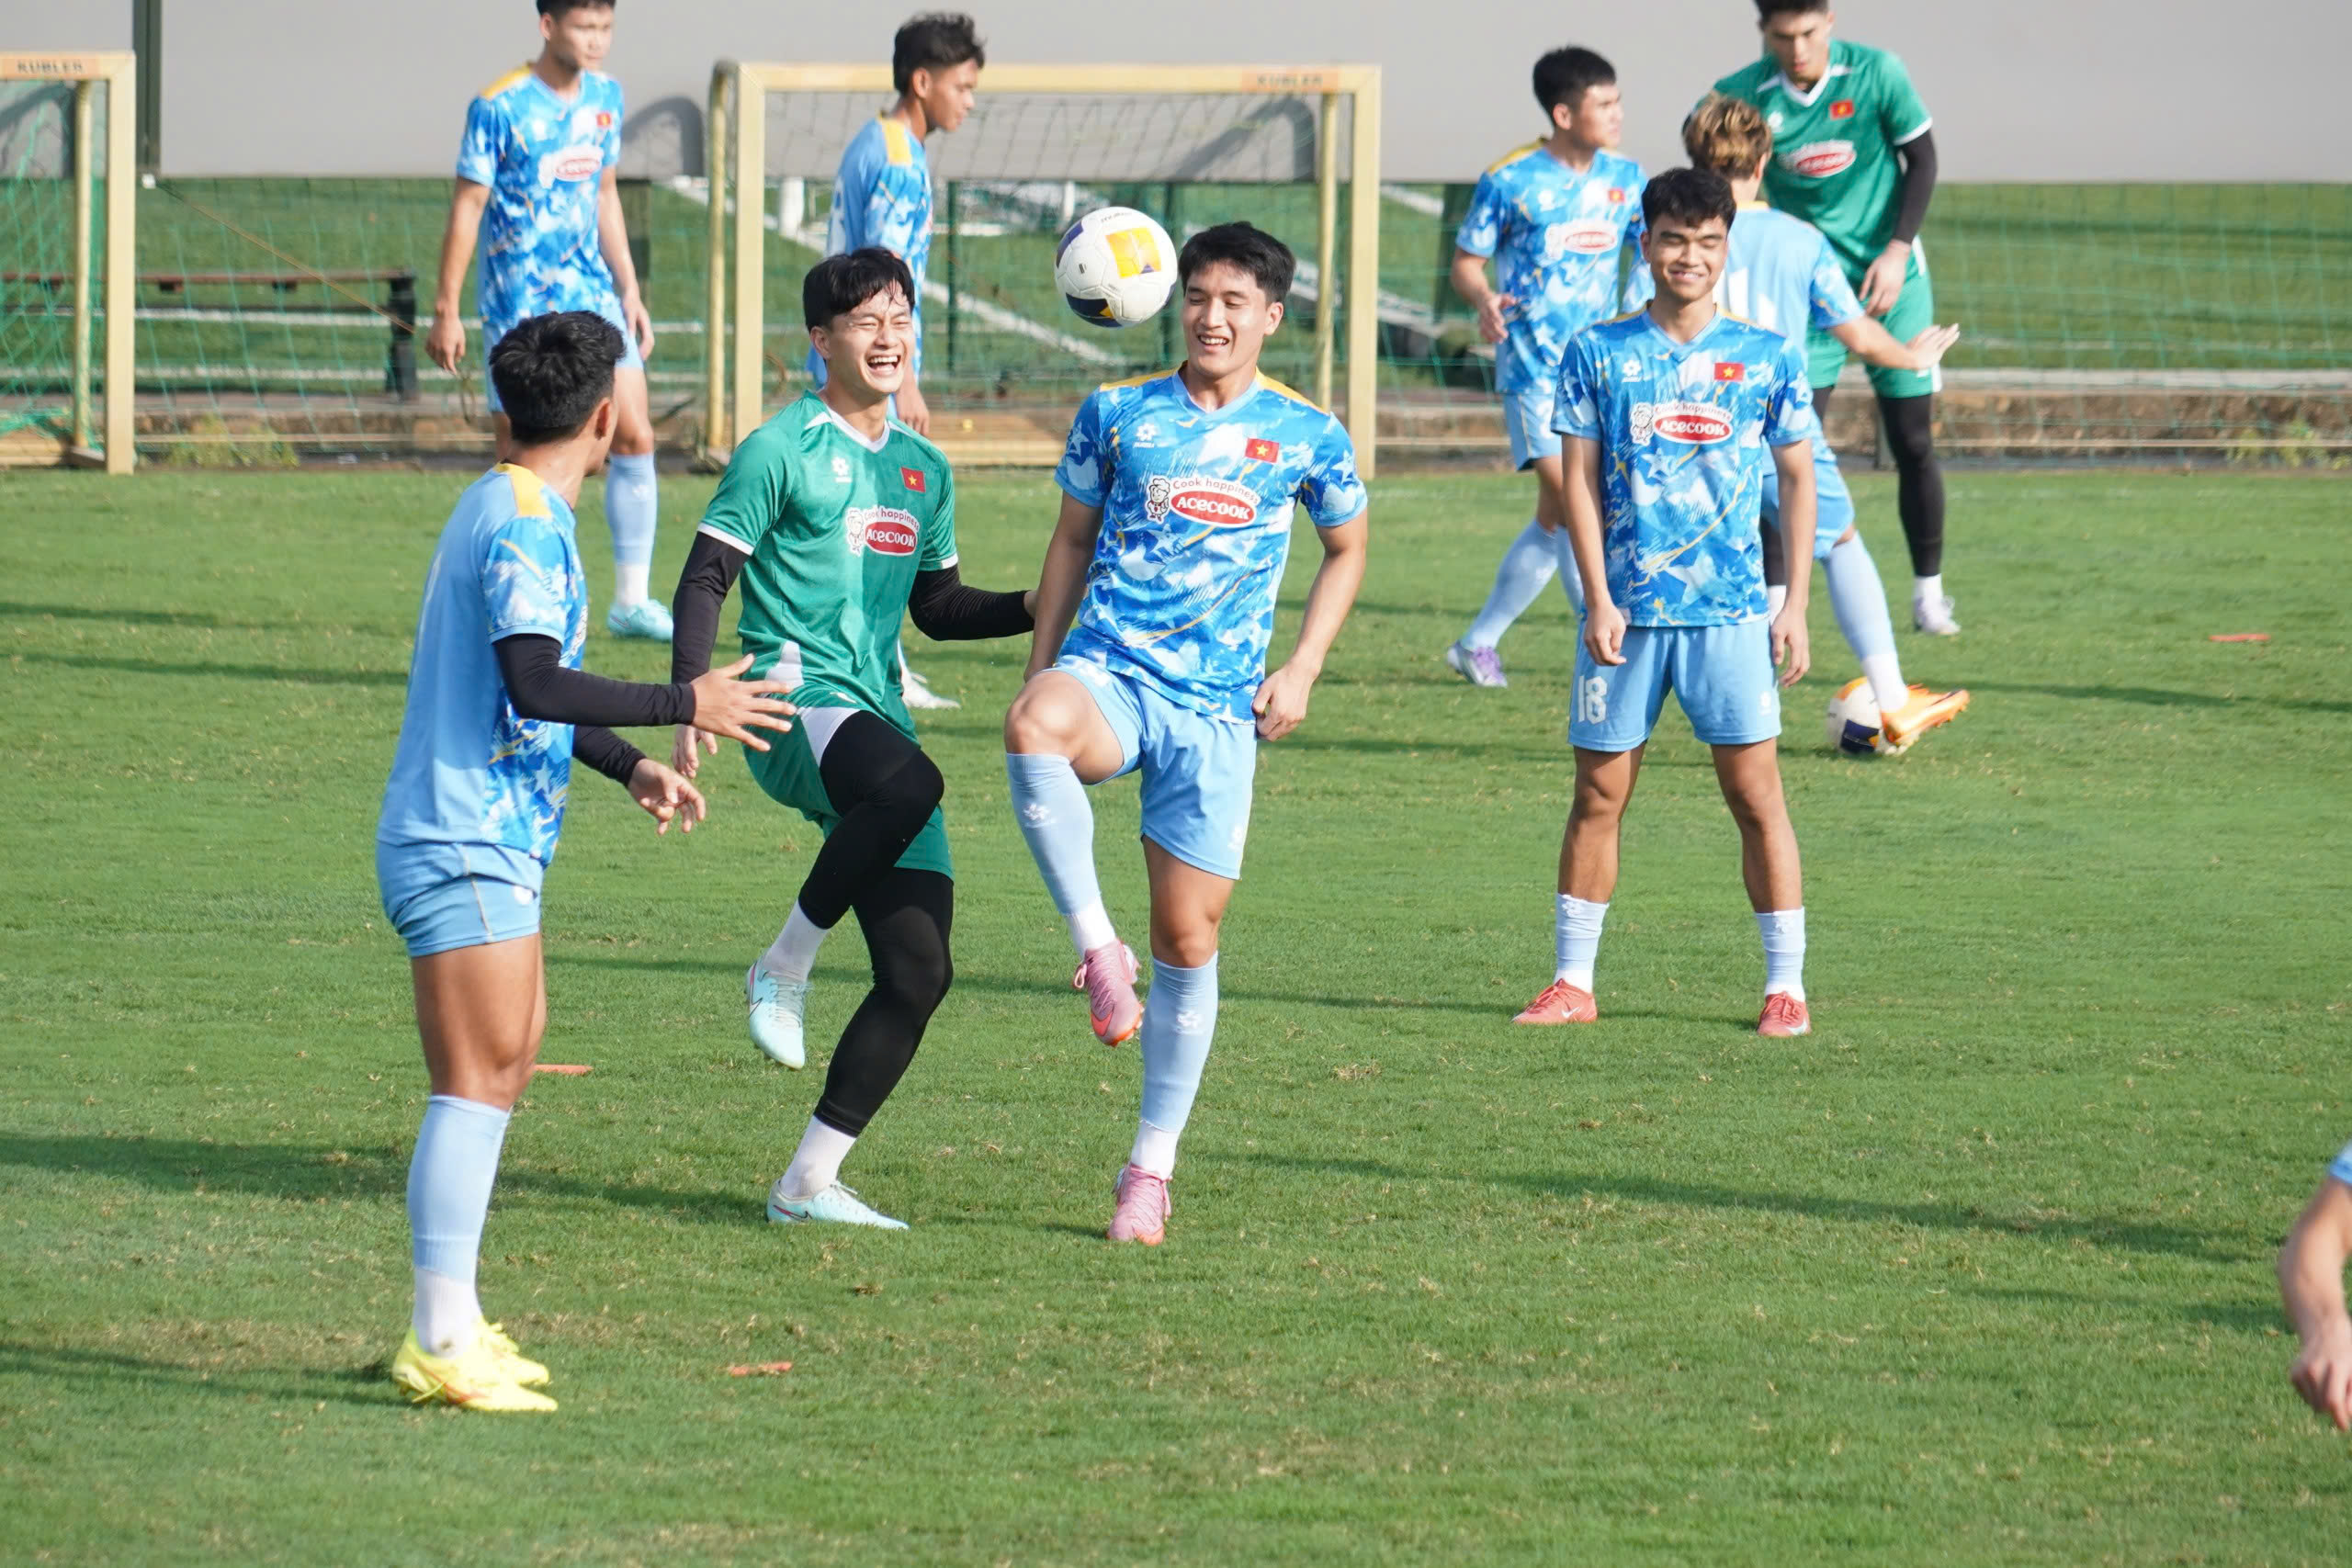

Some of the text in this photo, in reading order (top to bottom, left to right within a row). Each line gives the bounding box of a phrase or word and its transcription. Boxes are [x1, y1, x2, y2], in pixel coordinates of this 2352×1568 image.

[1172, 477, 1259, 504] Cook happiness
[881, 507, 920, 531] happiness
[1577, 675, 1608, 724] 18
